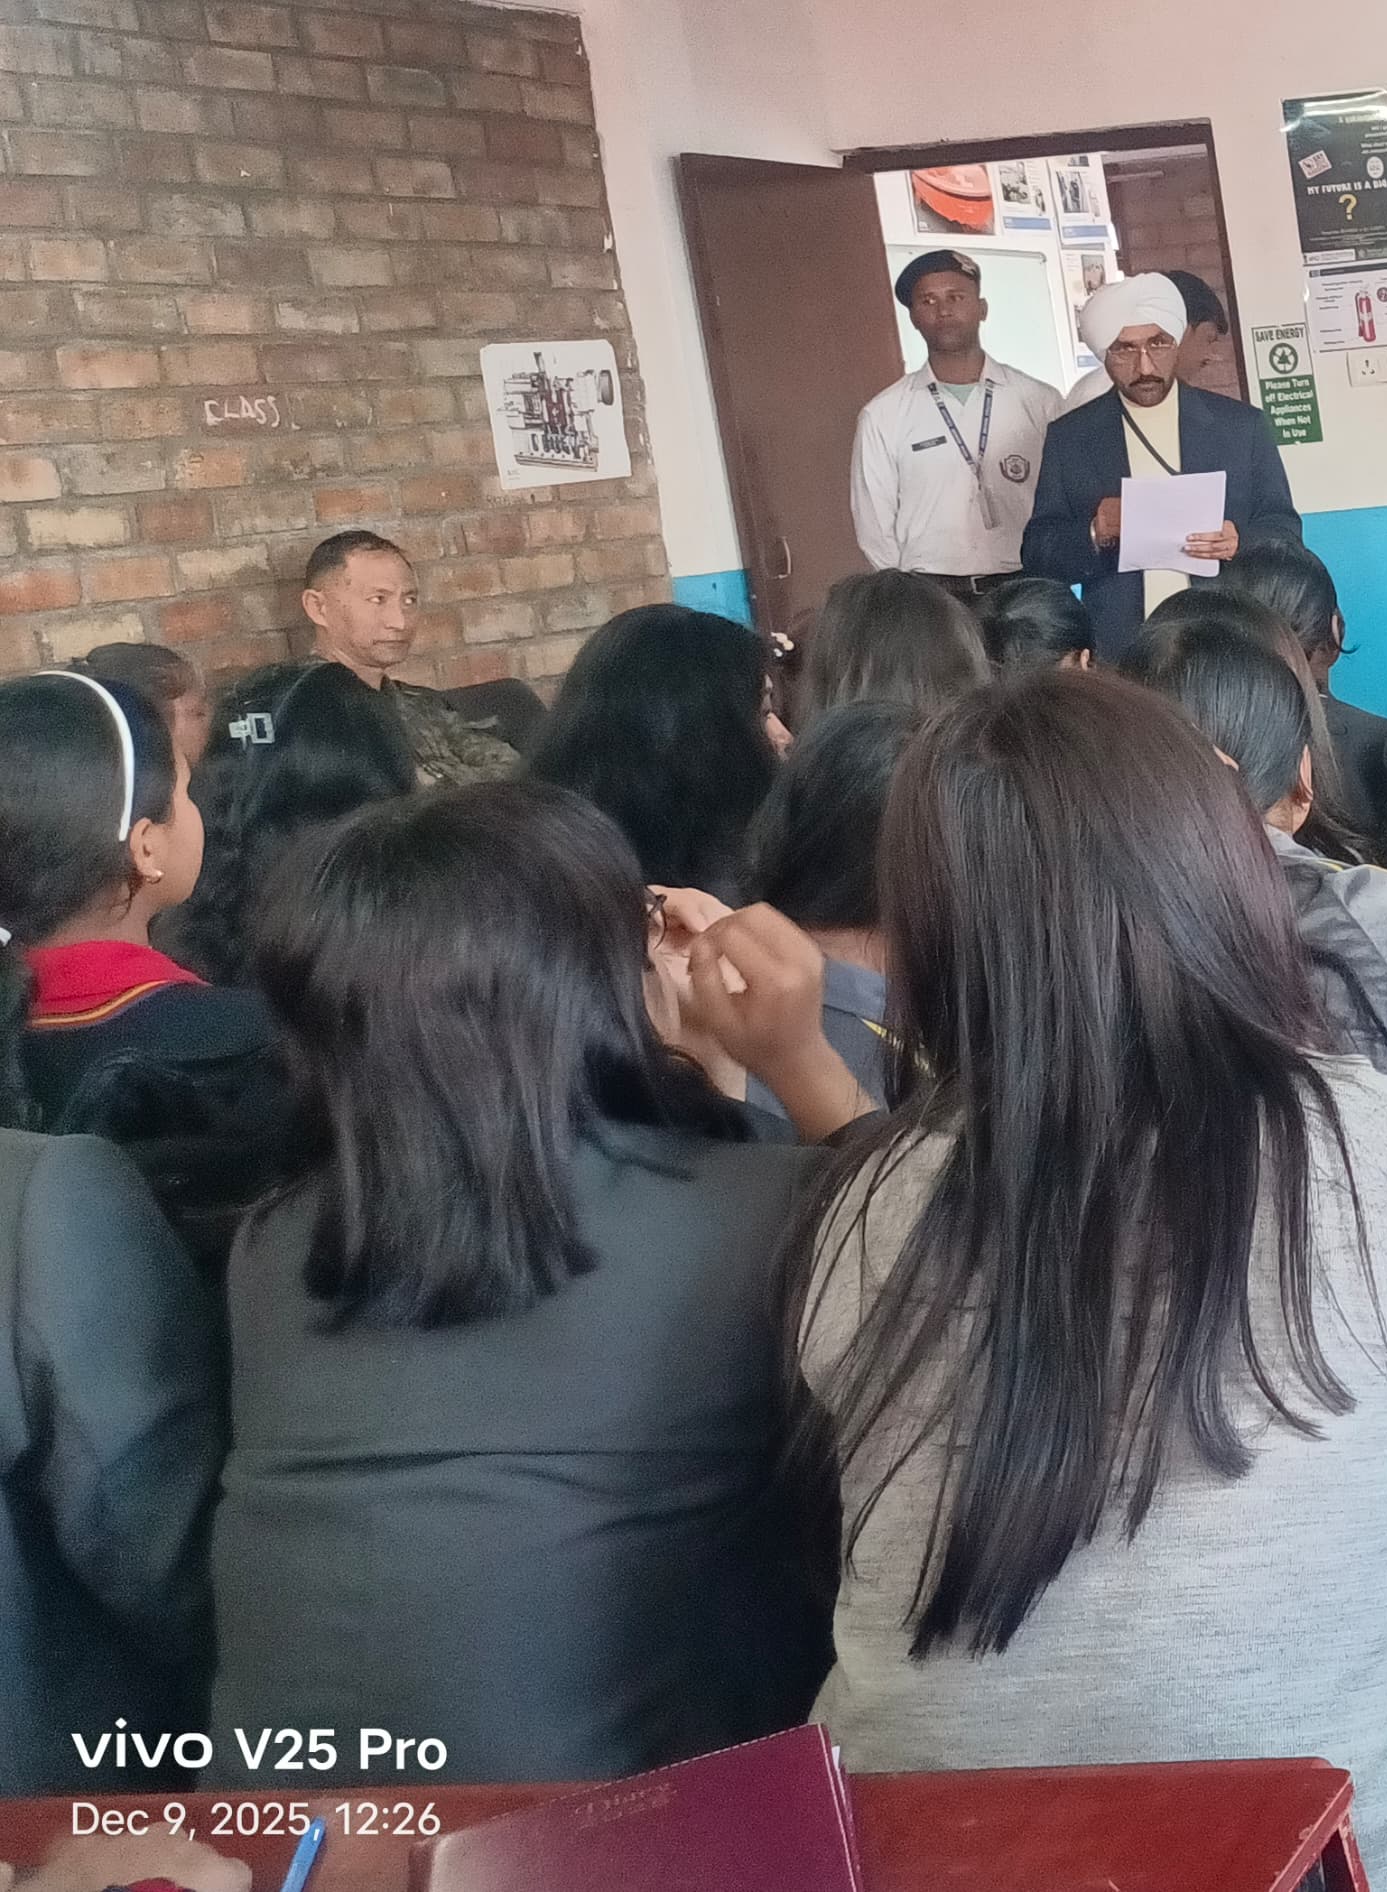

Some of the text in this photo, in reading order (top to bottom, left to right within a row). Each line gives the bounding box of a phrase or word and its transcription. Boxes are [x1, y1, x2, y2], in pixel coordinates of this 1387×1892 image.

[1307, 185, 1320, 195] MY
[1322, 182, 1352, 194] FUTURE
[1354, 181, 1363, 191] IS
[1364, 179, 1372, 189] A
[1338, 193, 1358, 220] ?
[1255, 327, 1304, 342] SAVE ENERGY
[1265, 378, 1310, 390] Please Turn
[1277, 390, 1314, 402] Electrical
[204, 395, 281, 428] CLASS
[1270, 403, 1312, 416] Appliances
[1274, 415, 1312, 427] When Not
